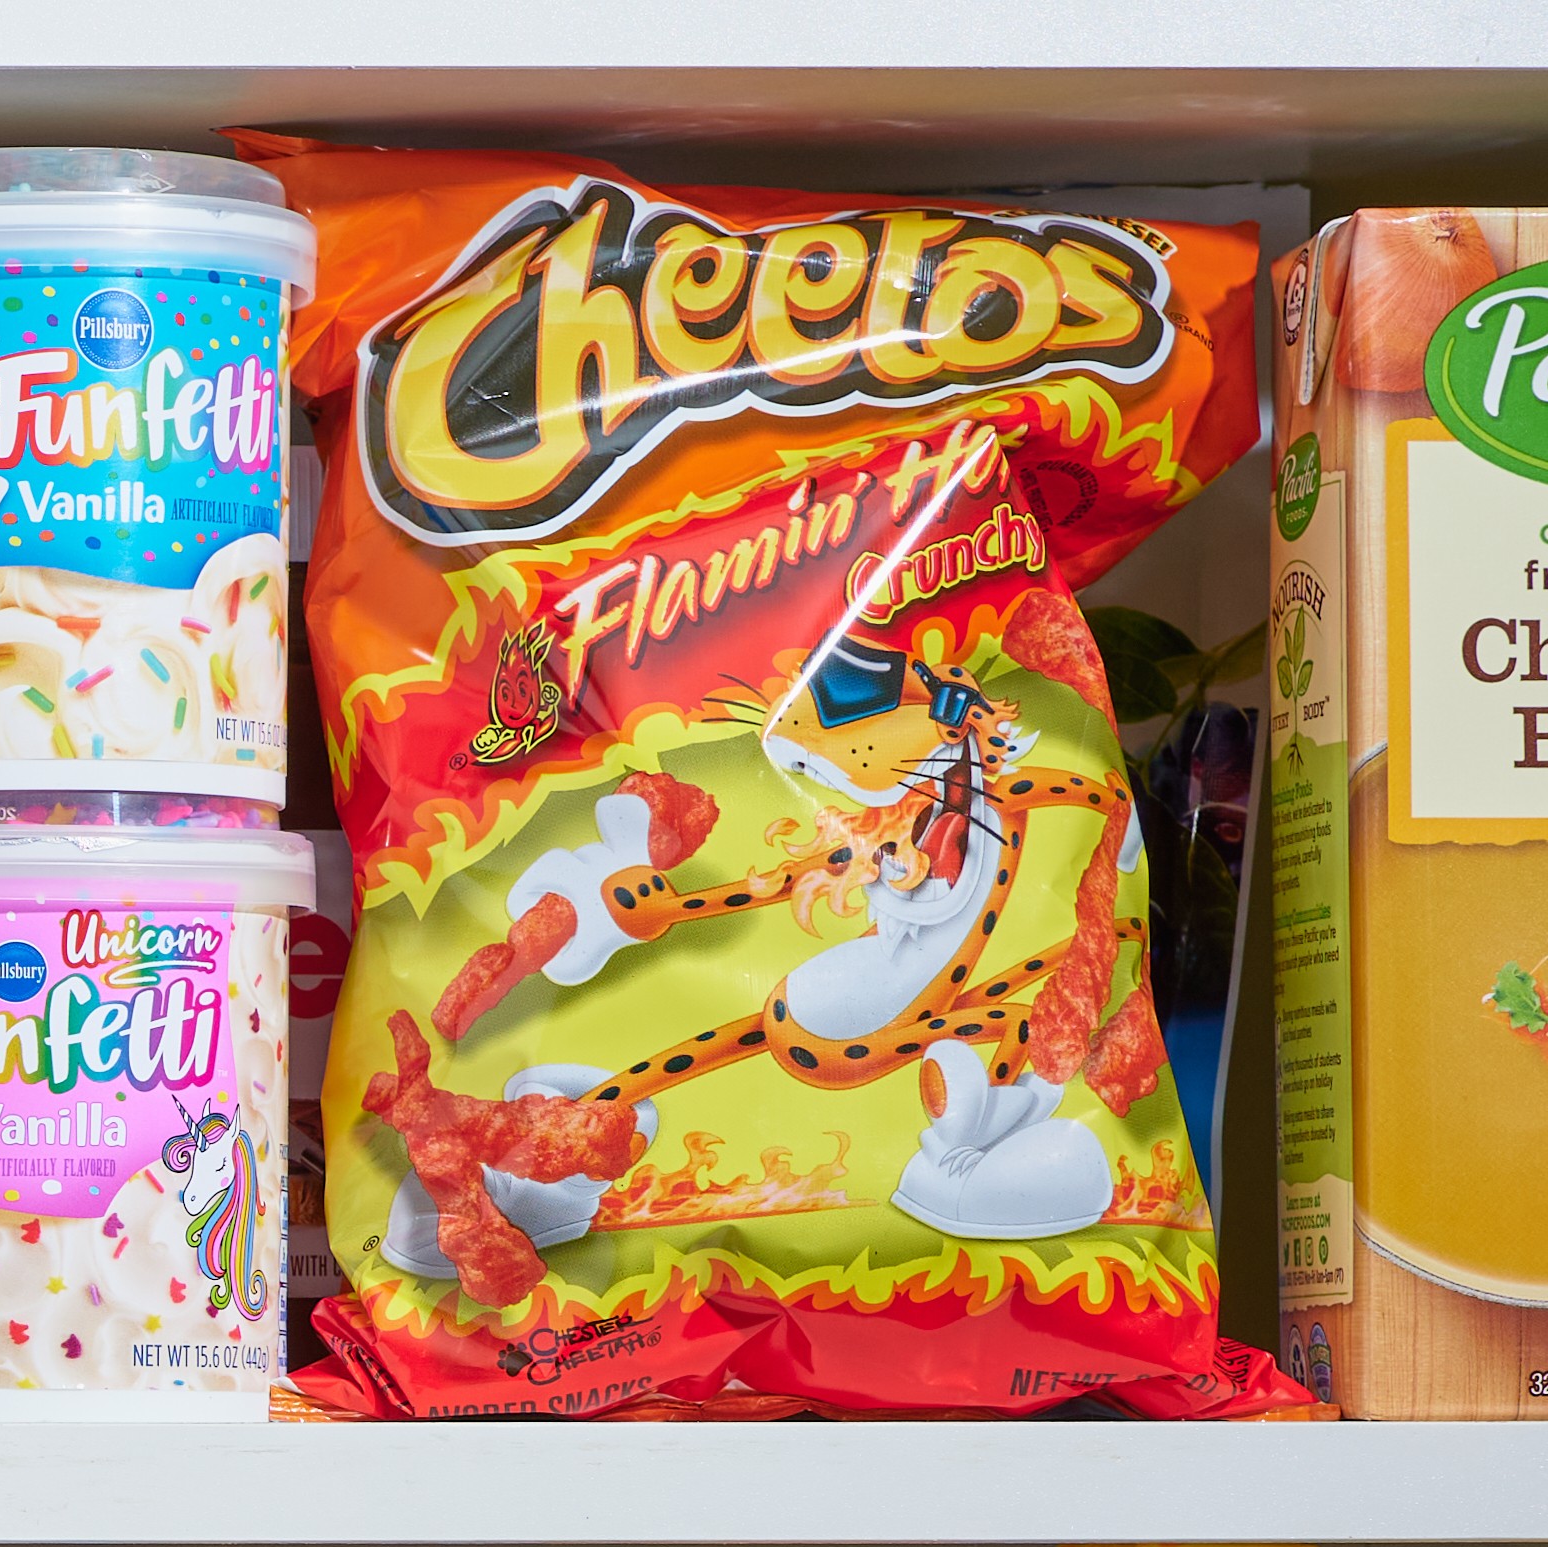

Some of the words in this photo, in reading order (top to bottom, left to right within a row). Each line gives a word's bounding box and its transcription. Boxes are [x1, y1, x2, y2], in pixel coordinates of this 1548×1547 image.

[381, 194, 1154, 513] Cheetos
[1281, 452, 1317, 504] Pacific
[844, 502, 1048, 625] Crunchy
[557, 471, 875, 718] Flamin'
[1272, 571, 1325, 632] NOURISH
[62, 909, 222, 967] Unicorn
[64, 1158, 116, 1178] FLAVORED
